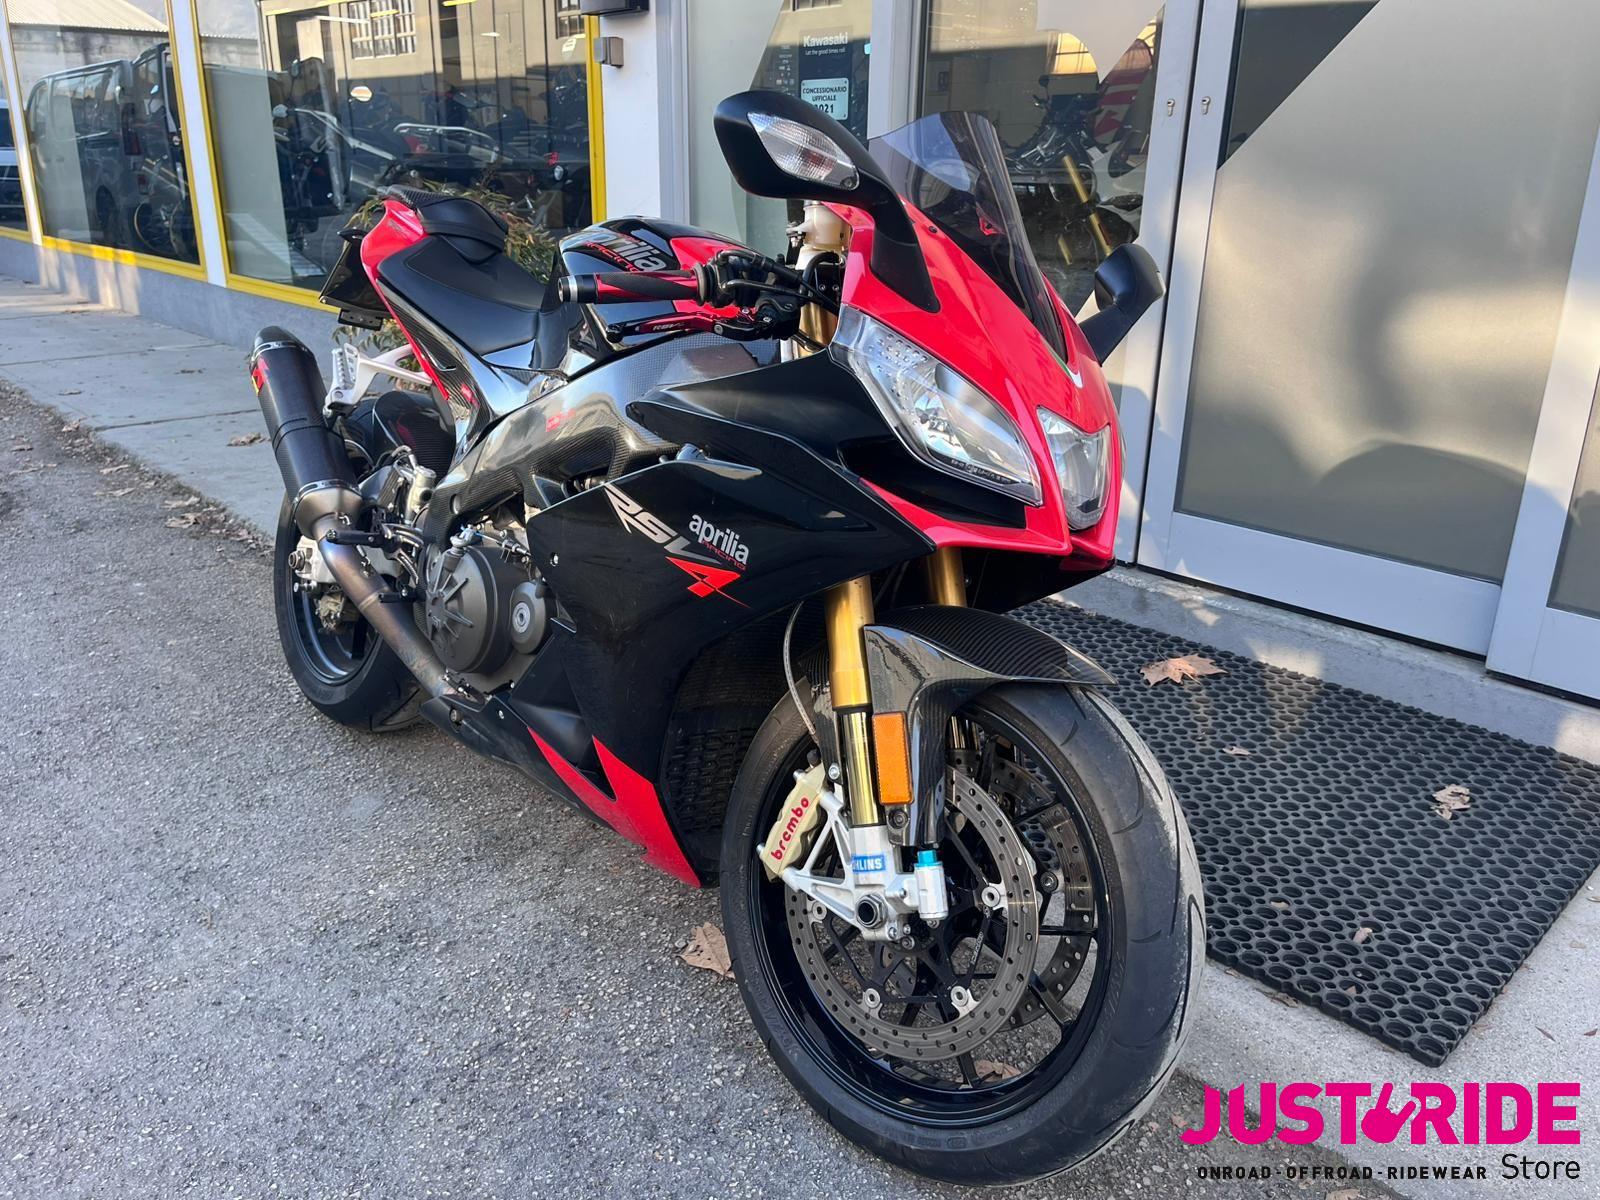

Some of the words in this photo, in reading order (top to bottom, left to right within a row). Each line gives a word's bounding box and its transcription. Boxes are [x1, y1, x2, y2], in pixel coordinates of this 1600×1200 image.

[803, 32, 848, 48] Kawasaki
[818, 48, 829, 56] good
[802, 86, 848, 94] CONCESSIONARIO
[688, 514, 749, 565] aprilia
[770, 797, 809, 860] brembo
